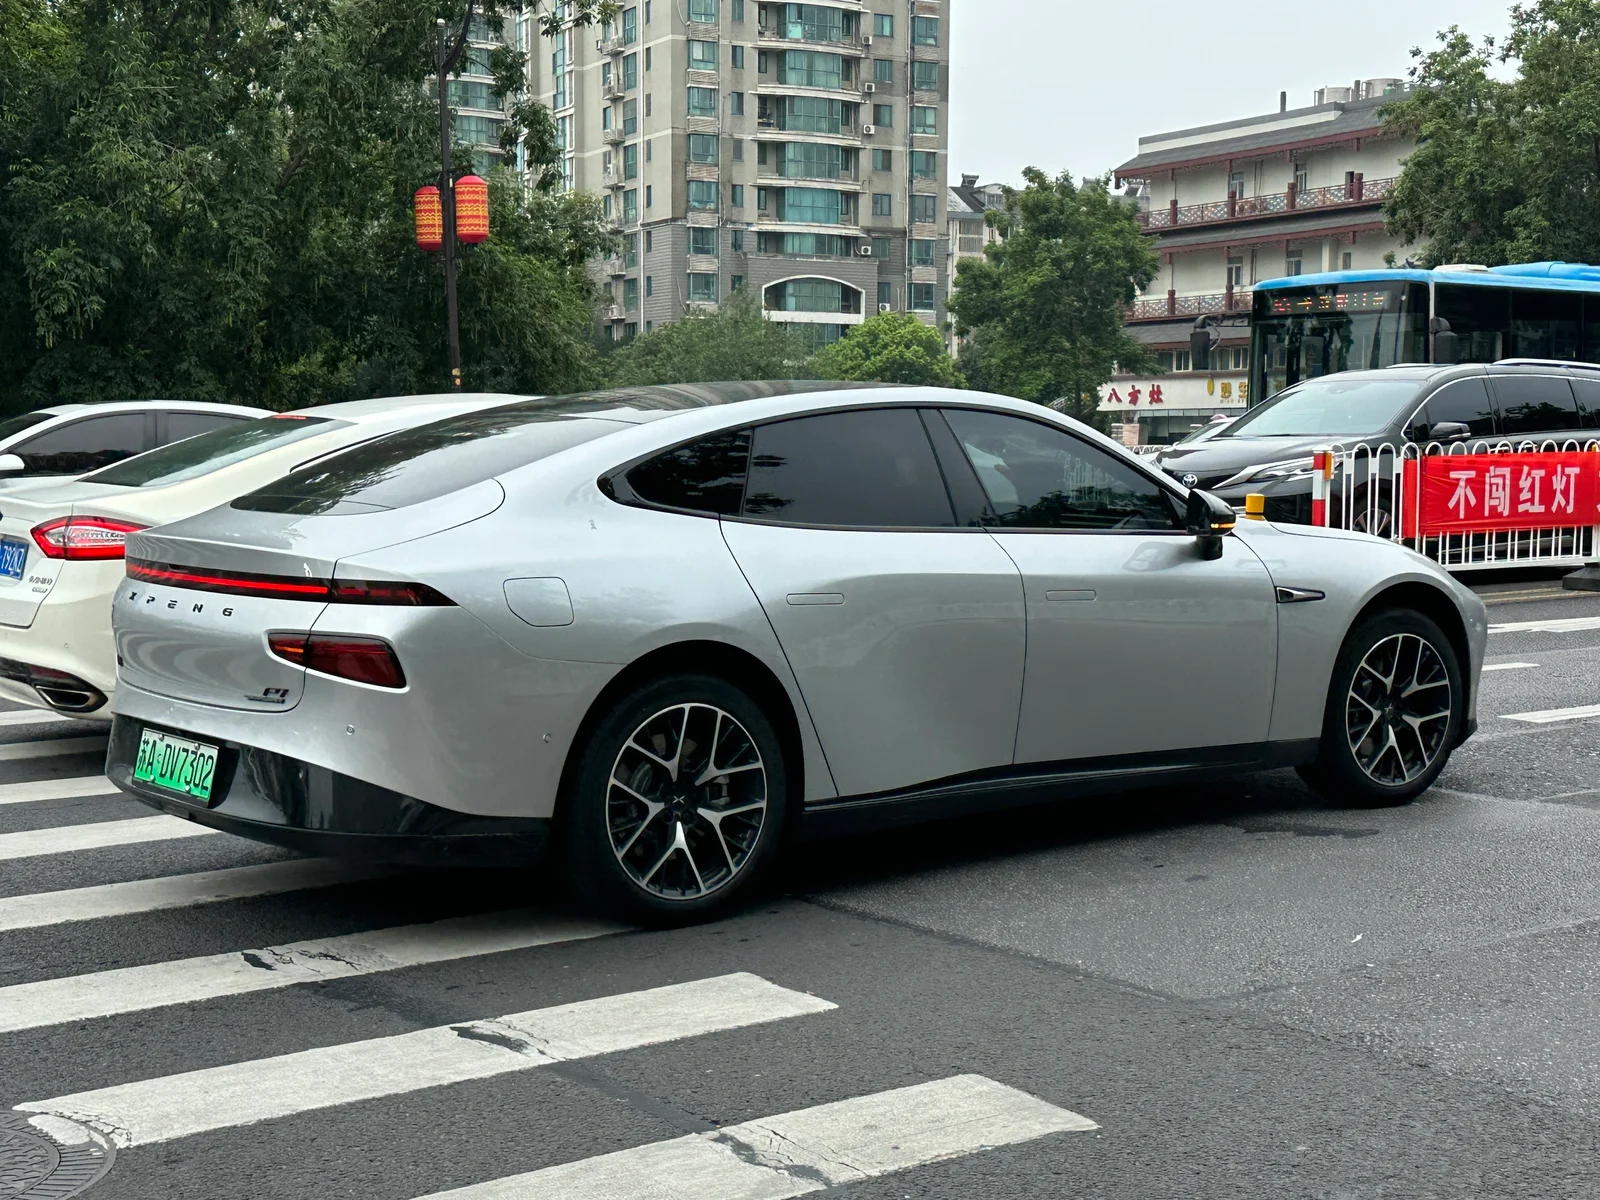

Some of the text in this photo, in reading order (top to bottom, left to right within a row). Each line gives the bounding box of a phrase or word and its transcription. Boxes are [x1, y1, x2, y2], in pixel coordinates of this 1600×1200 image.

[1447, 463, 1581, 520] 不闯红灯
[128, 591, 235, 617] XPENG
